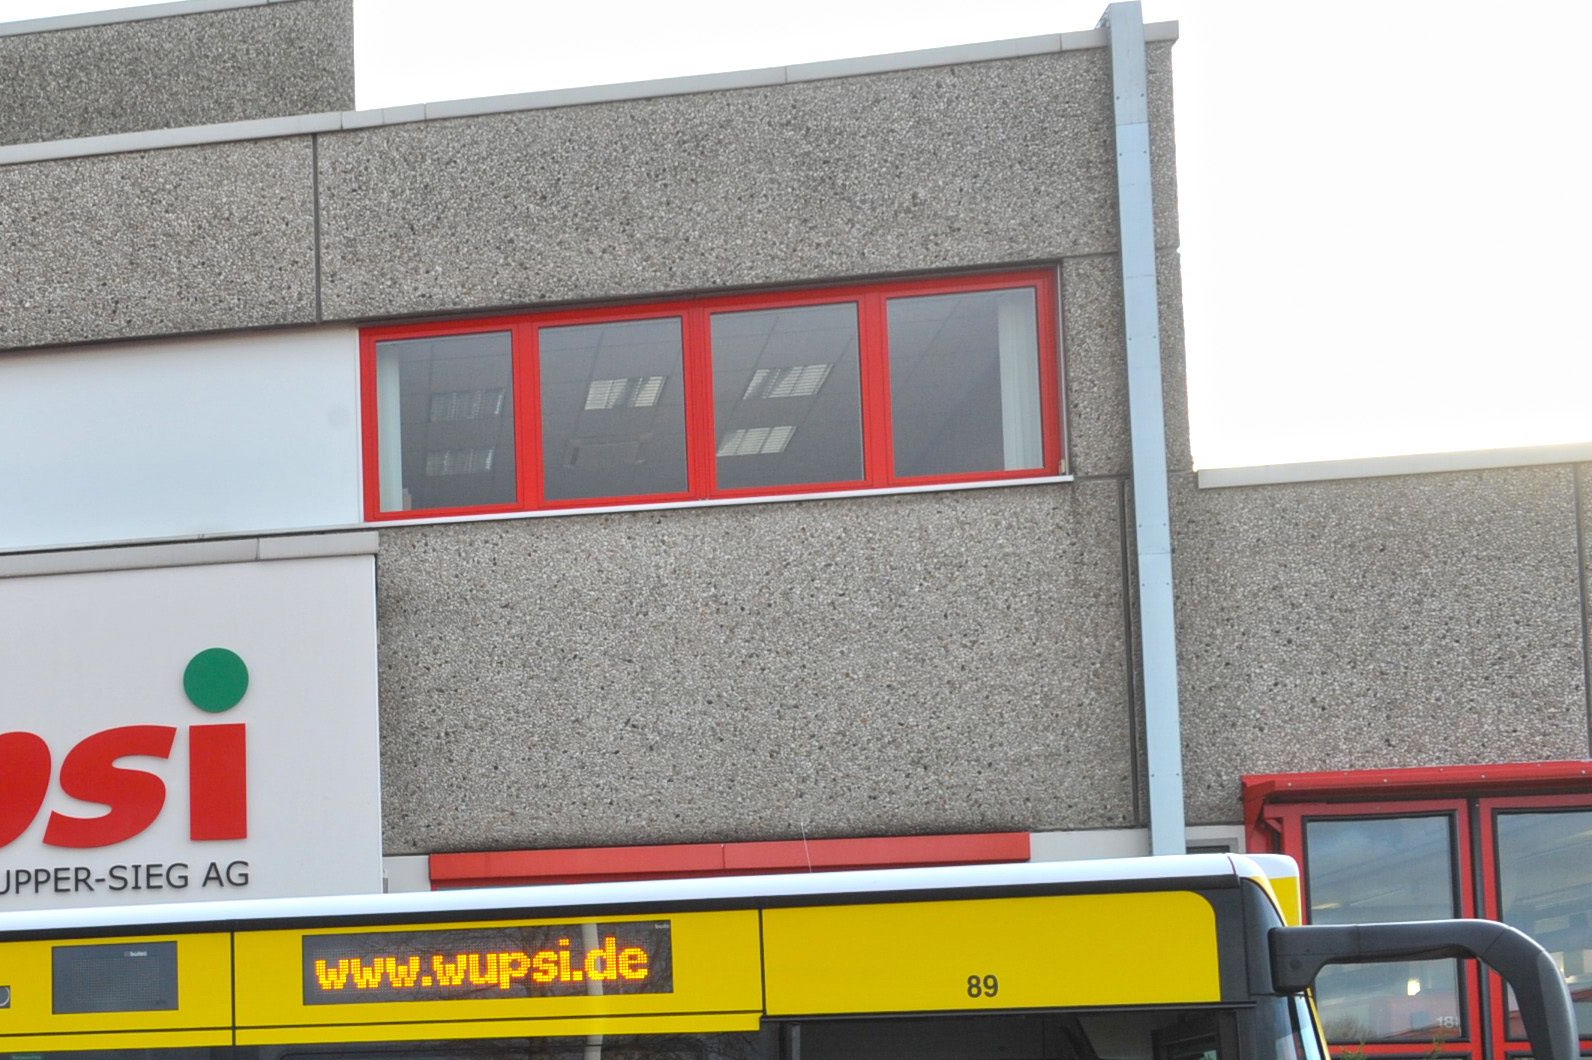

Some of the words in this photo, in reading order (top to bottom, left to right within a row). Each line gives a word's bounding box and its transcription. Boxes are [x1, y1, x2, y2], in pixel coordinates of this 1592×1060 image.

[202, 860, 250, 888] AG
[315, 936, 648, 990] www.wupsi.de
[966, 974, 999, 998] 89
